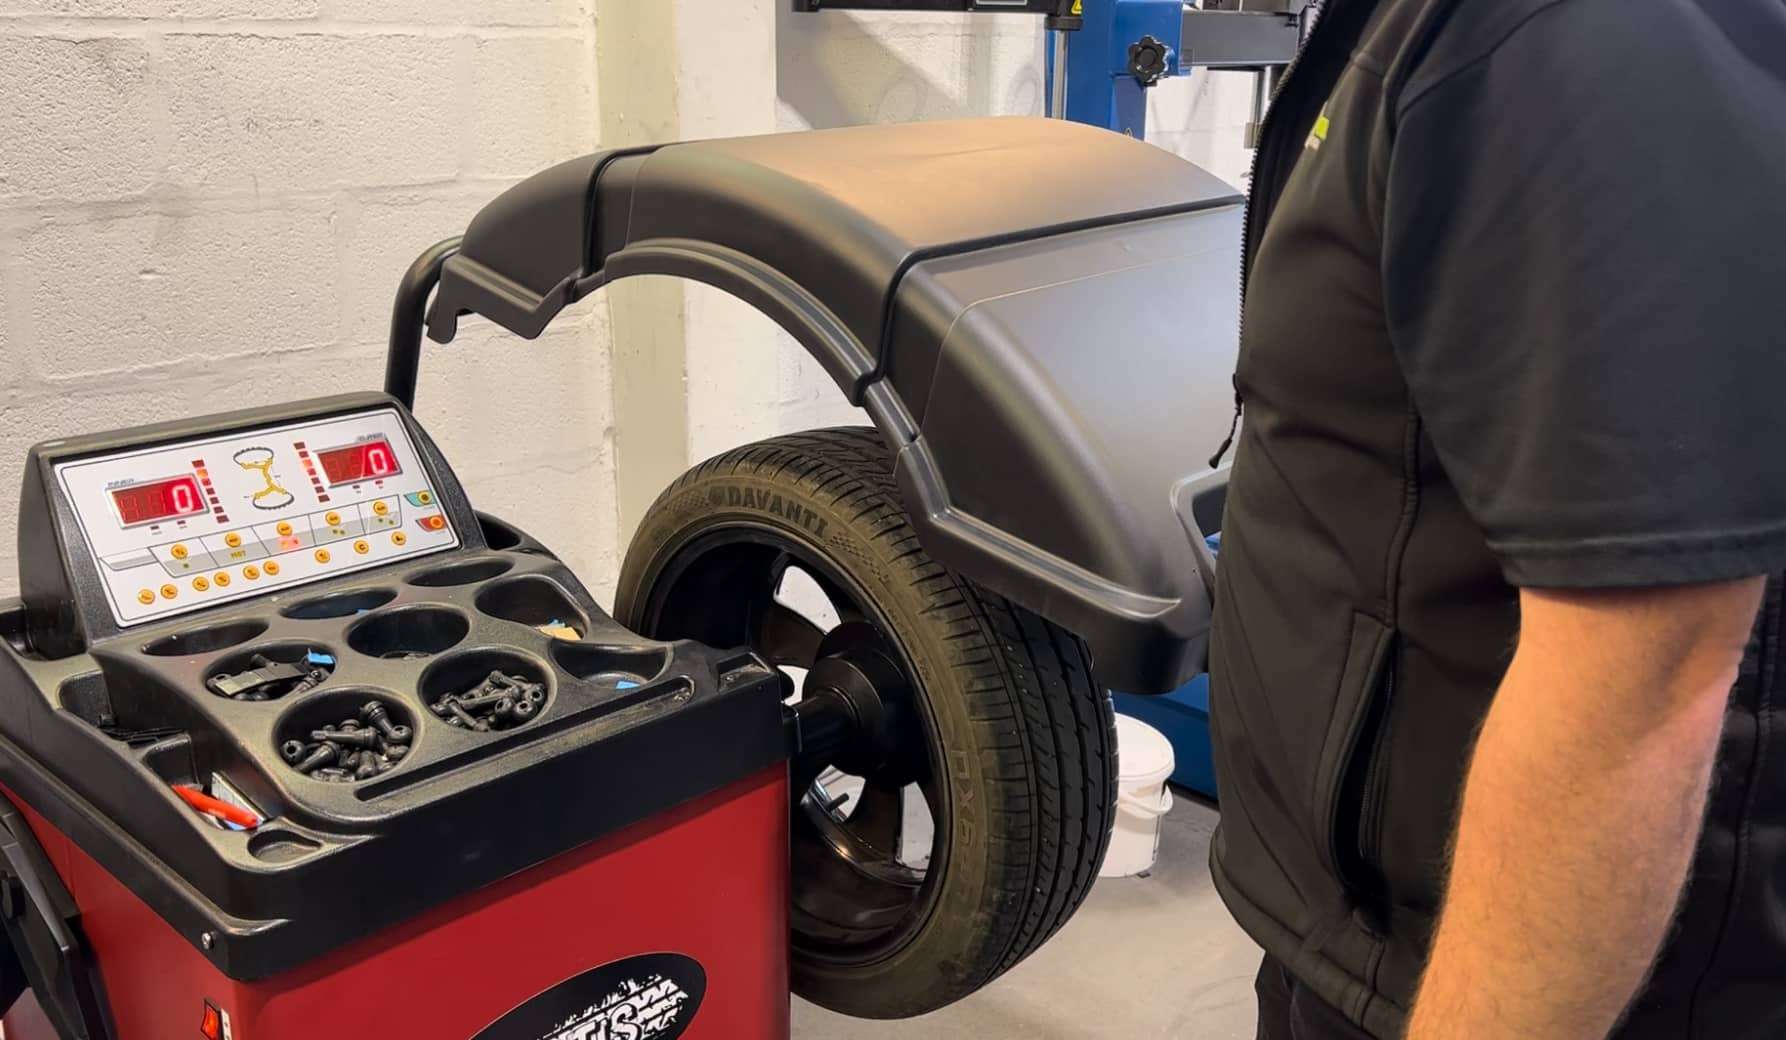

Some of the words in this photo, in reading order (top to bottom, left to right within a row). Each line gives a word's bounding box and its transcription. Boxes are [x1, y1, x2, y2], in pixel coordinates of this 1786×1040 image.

[369, 449, 387, 475] 0
[172, 485, 193, 512] 0
[727, 486, 828, 537] DAVANTI
